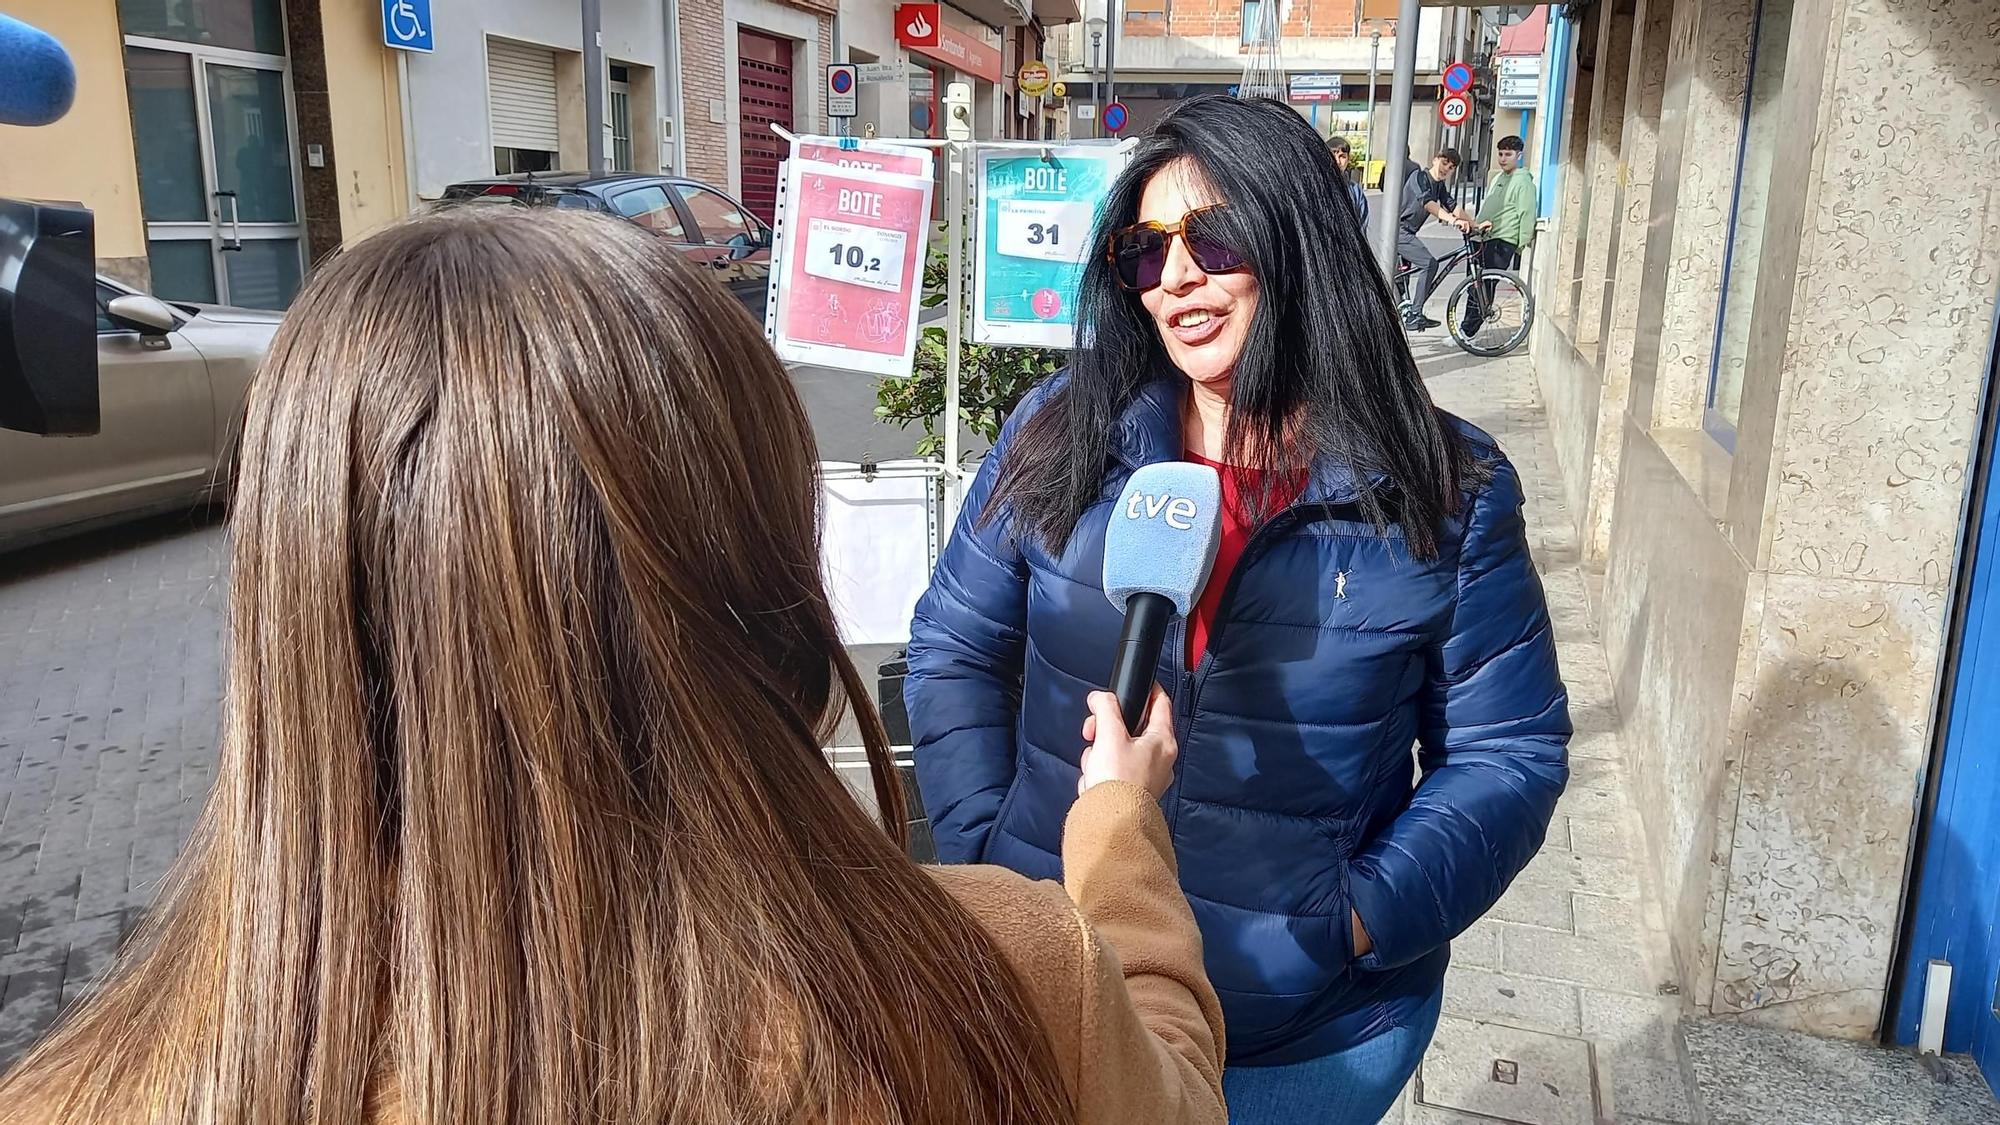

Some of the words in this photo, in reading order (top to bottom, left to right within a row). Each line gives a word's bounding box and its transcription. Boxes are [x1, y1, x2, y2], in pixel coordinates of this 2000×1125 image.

[1446, 104, 1464, 116] 20
[1024, 167, 1068, 192] BOTE
[838, 188, 883, 217] BOTE
[1027, 223, 1059, 245] 31
[829, 243, 881, 273] 10,2
[1126, 490, 1197, 530] tve
